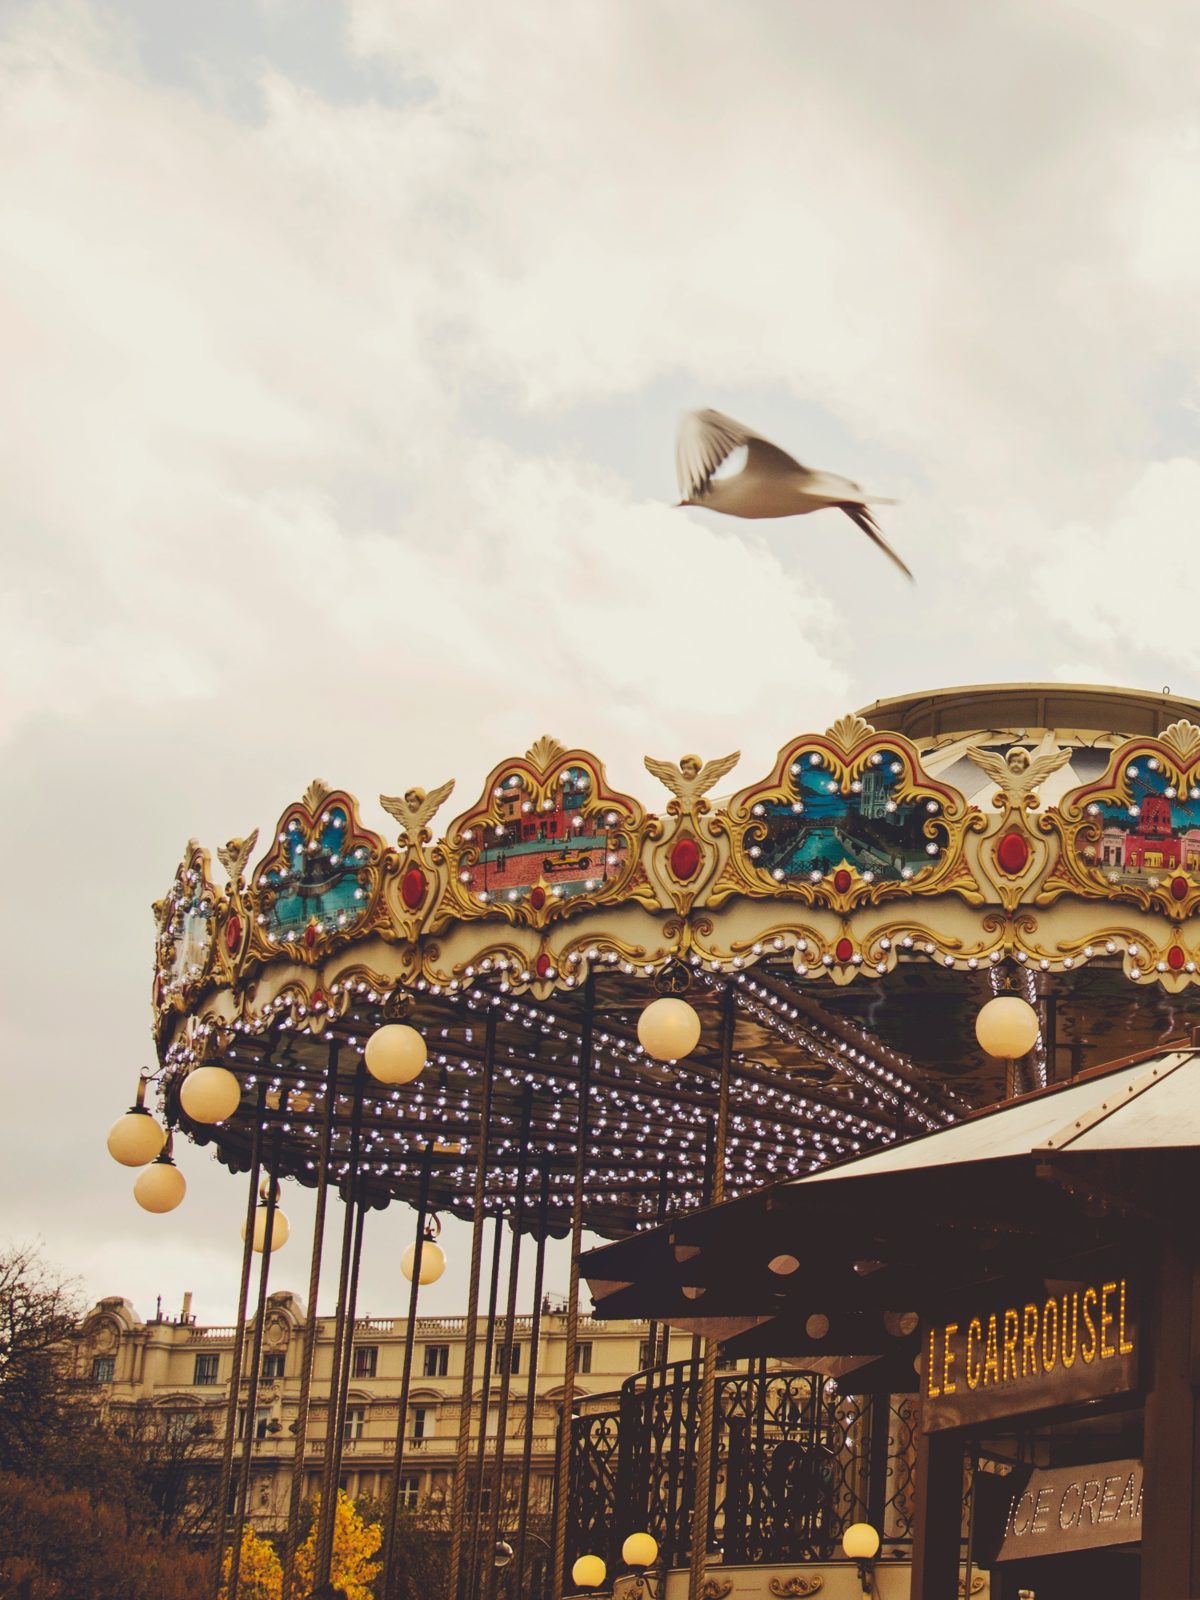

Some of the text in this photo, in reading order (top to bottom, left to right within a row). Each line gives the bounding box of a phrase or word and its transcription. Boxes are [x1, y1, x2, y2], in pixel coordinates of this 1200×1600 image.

[928, 1278, 1134, 1397] LE CARROUSEL
[1003, 1472, 1144, 1537] ICE CREA
